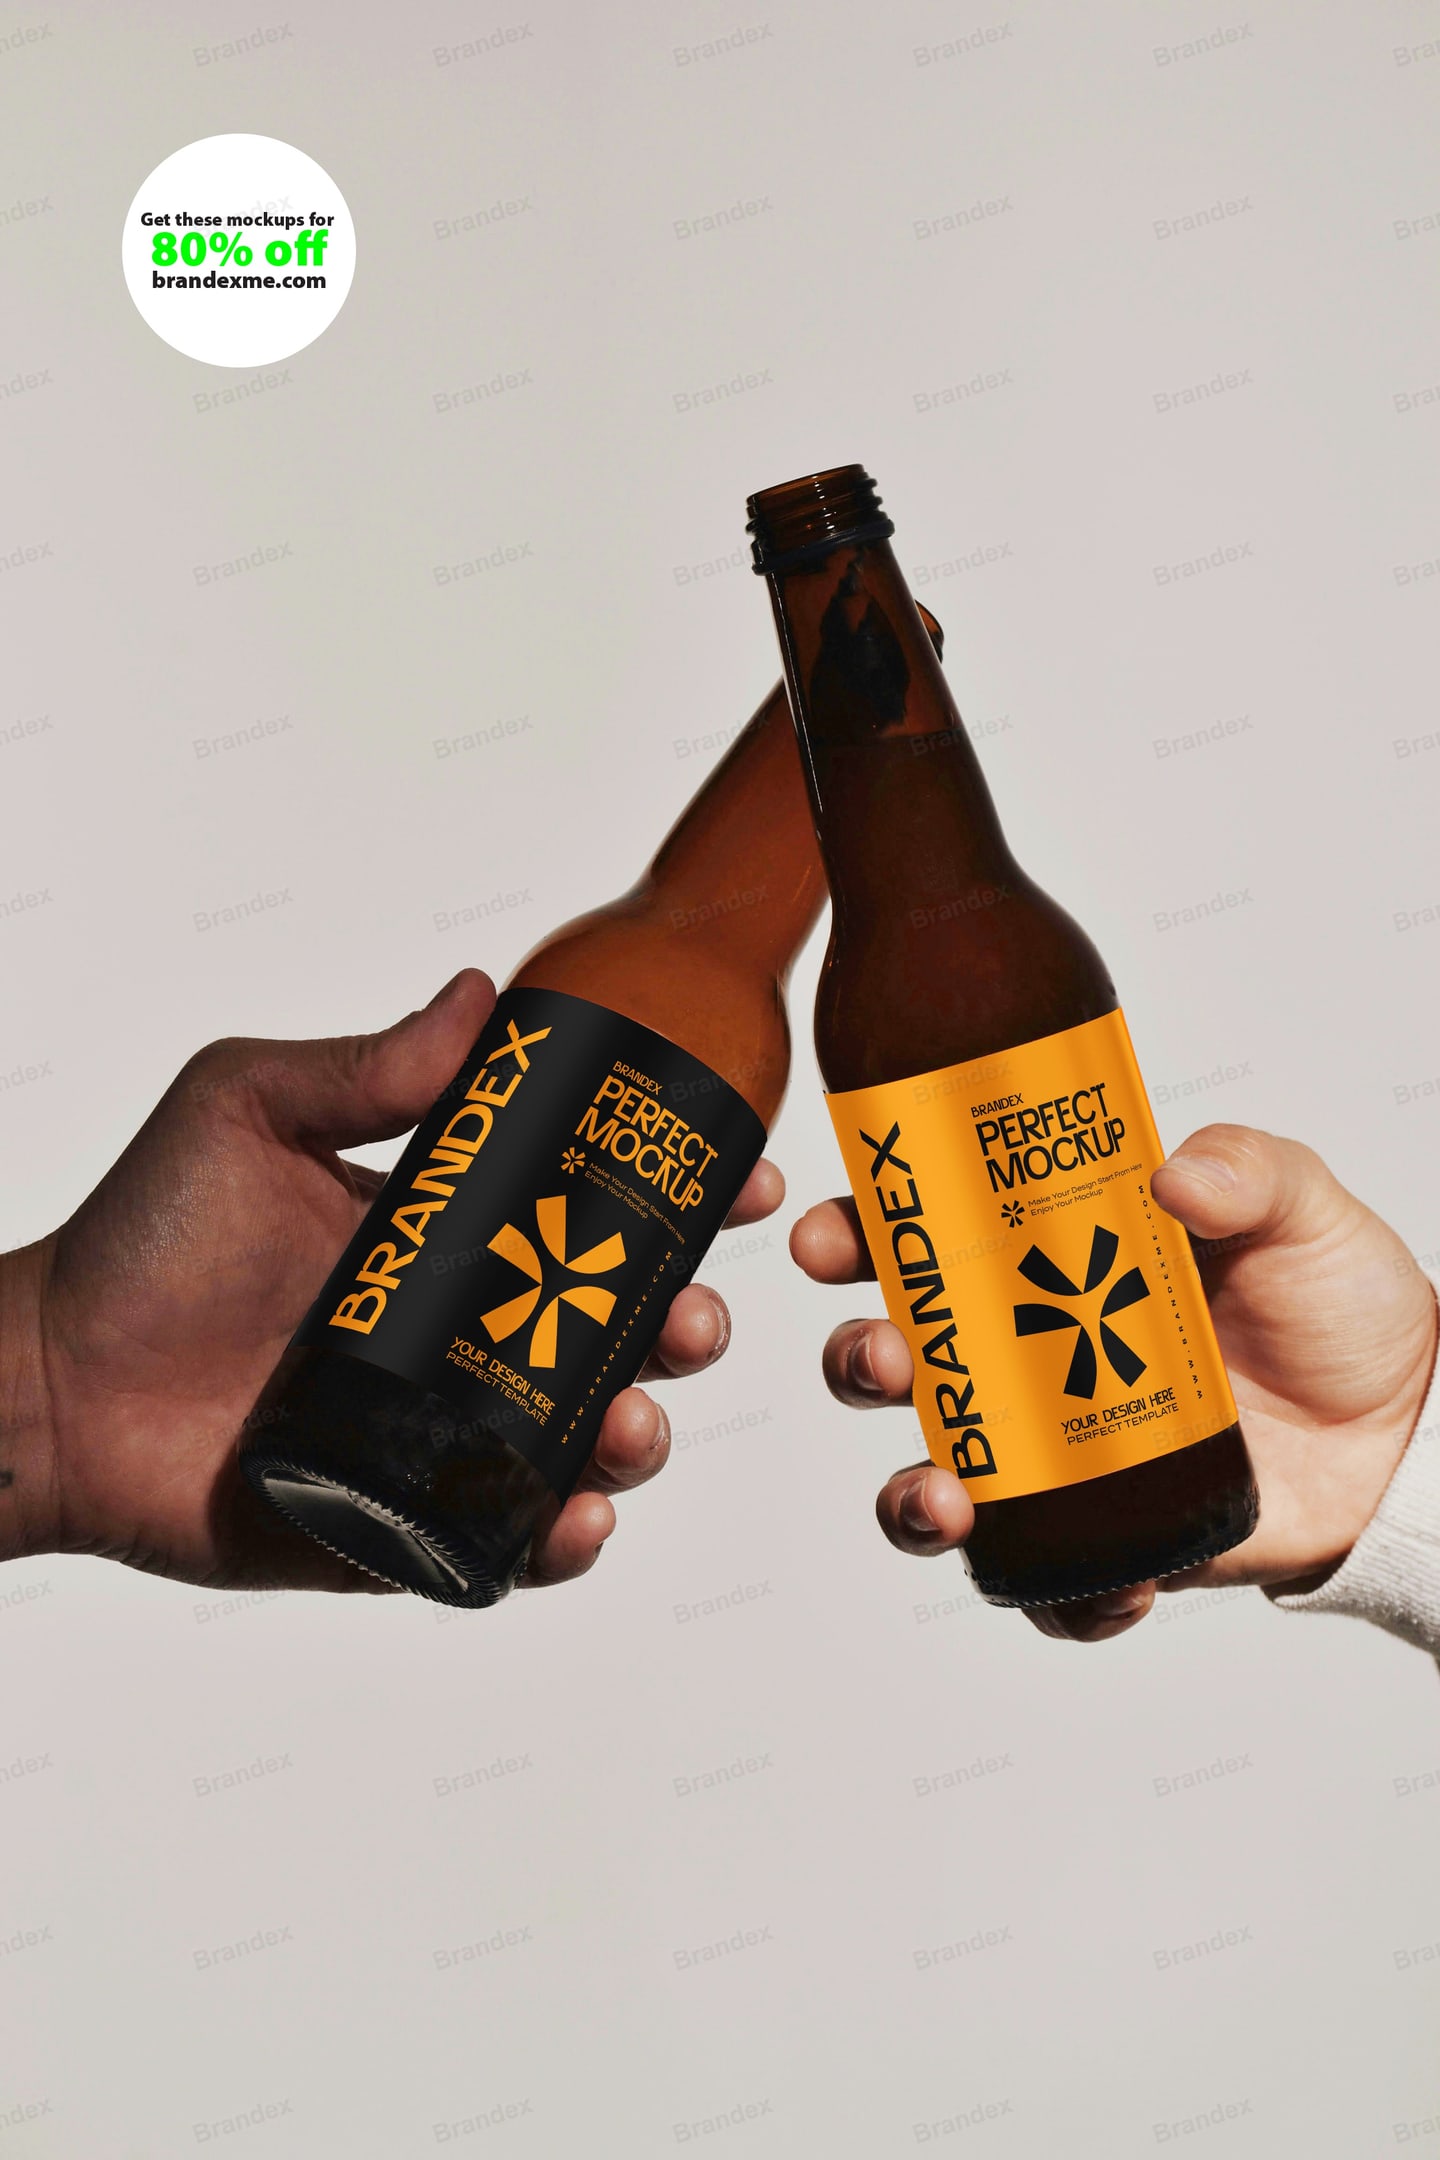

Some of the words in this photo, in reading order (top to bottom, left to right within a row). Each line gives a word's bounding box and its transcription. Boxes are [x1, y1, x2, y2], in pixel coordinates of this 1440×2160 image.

[612, 1060, 663, 1096] BRANDEX
[970, 1093, 1025, 1118] BRANDEX
[593, 1074, 719, 1178] PERFECT
[975, 1082, 1108, 1157] PERFECT
[328, 1019, 552, 1335] BRANDEX
[574, 1105, 704, 1212] MOCKUP
[589, 1162, 611, 1180] Make
[611, 1176, 628, 1191] Your
[627, 1187, 650, 1209] Design
[985, 1117, 1125, 1193] MOCKUP
[584, 1171, 606, 1189] Enjoy
[607, 1183, 624, 1198] Your
[623, 1196, 649, 1220] Mockup
[1028, 1195, 1051, 1208] Make
[1051, 1189, 1070, 1200] Your
[1071, 1180, 1097, 1194] Design
[1097, 1174, 1114, 1185] Start
[1114, 1168, 1130, 1180] From
[1030, 1204, 1054, 1217] Enjoy
[1055, 1198, 1073, 1210] Your
[1074, 1187, 1104, 1202] Mockup
[858, 1120, 998, 1480] BRANDEX
[446, 1351, 500, 1387] PERFECT
[499, 1382, 548, 1426] TEMPLATE
[450, 1336, 488, 1366] YOUR
[488, 1358, 531, 1395] DESIGN
[530, 1387, 556, 1416] HERE
[1061, 1413, 1097, 1434] YOUR
[1102, 1397, 1147, 1423] DESIGN
[1149, 1387, 1176, 1406] HERE
[1067, 1422, 1122, 1445] PERFECT
[1122, 1402, 1179, 1430] TEMPLATE
